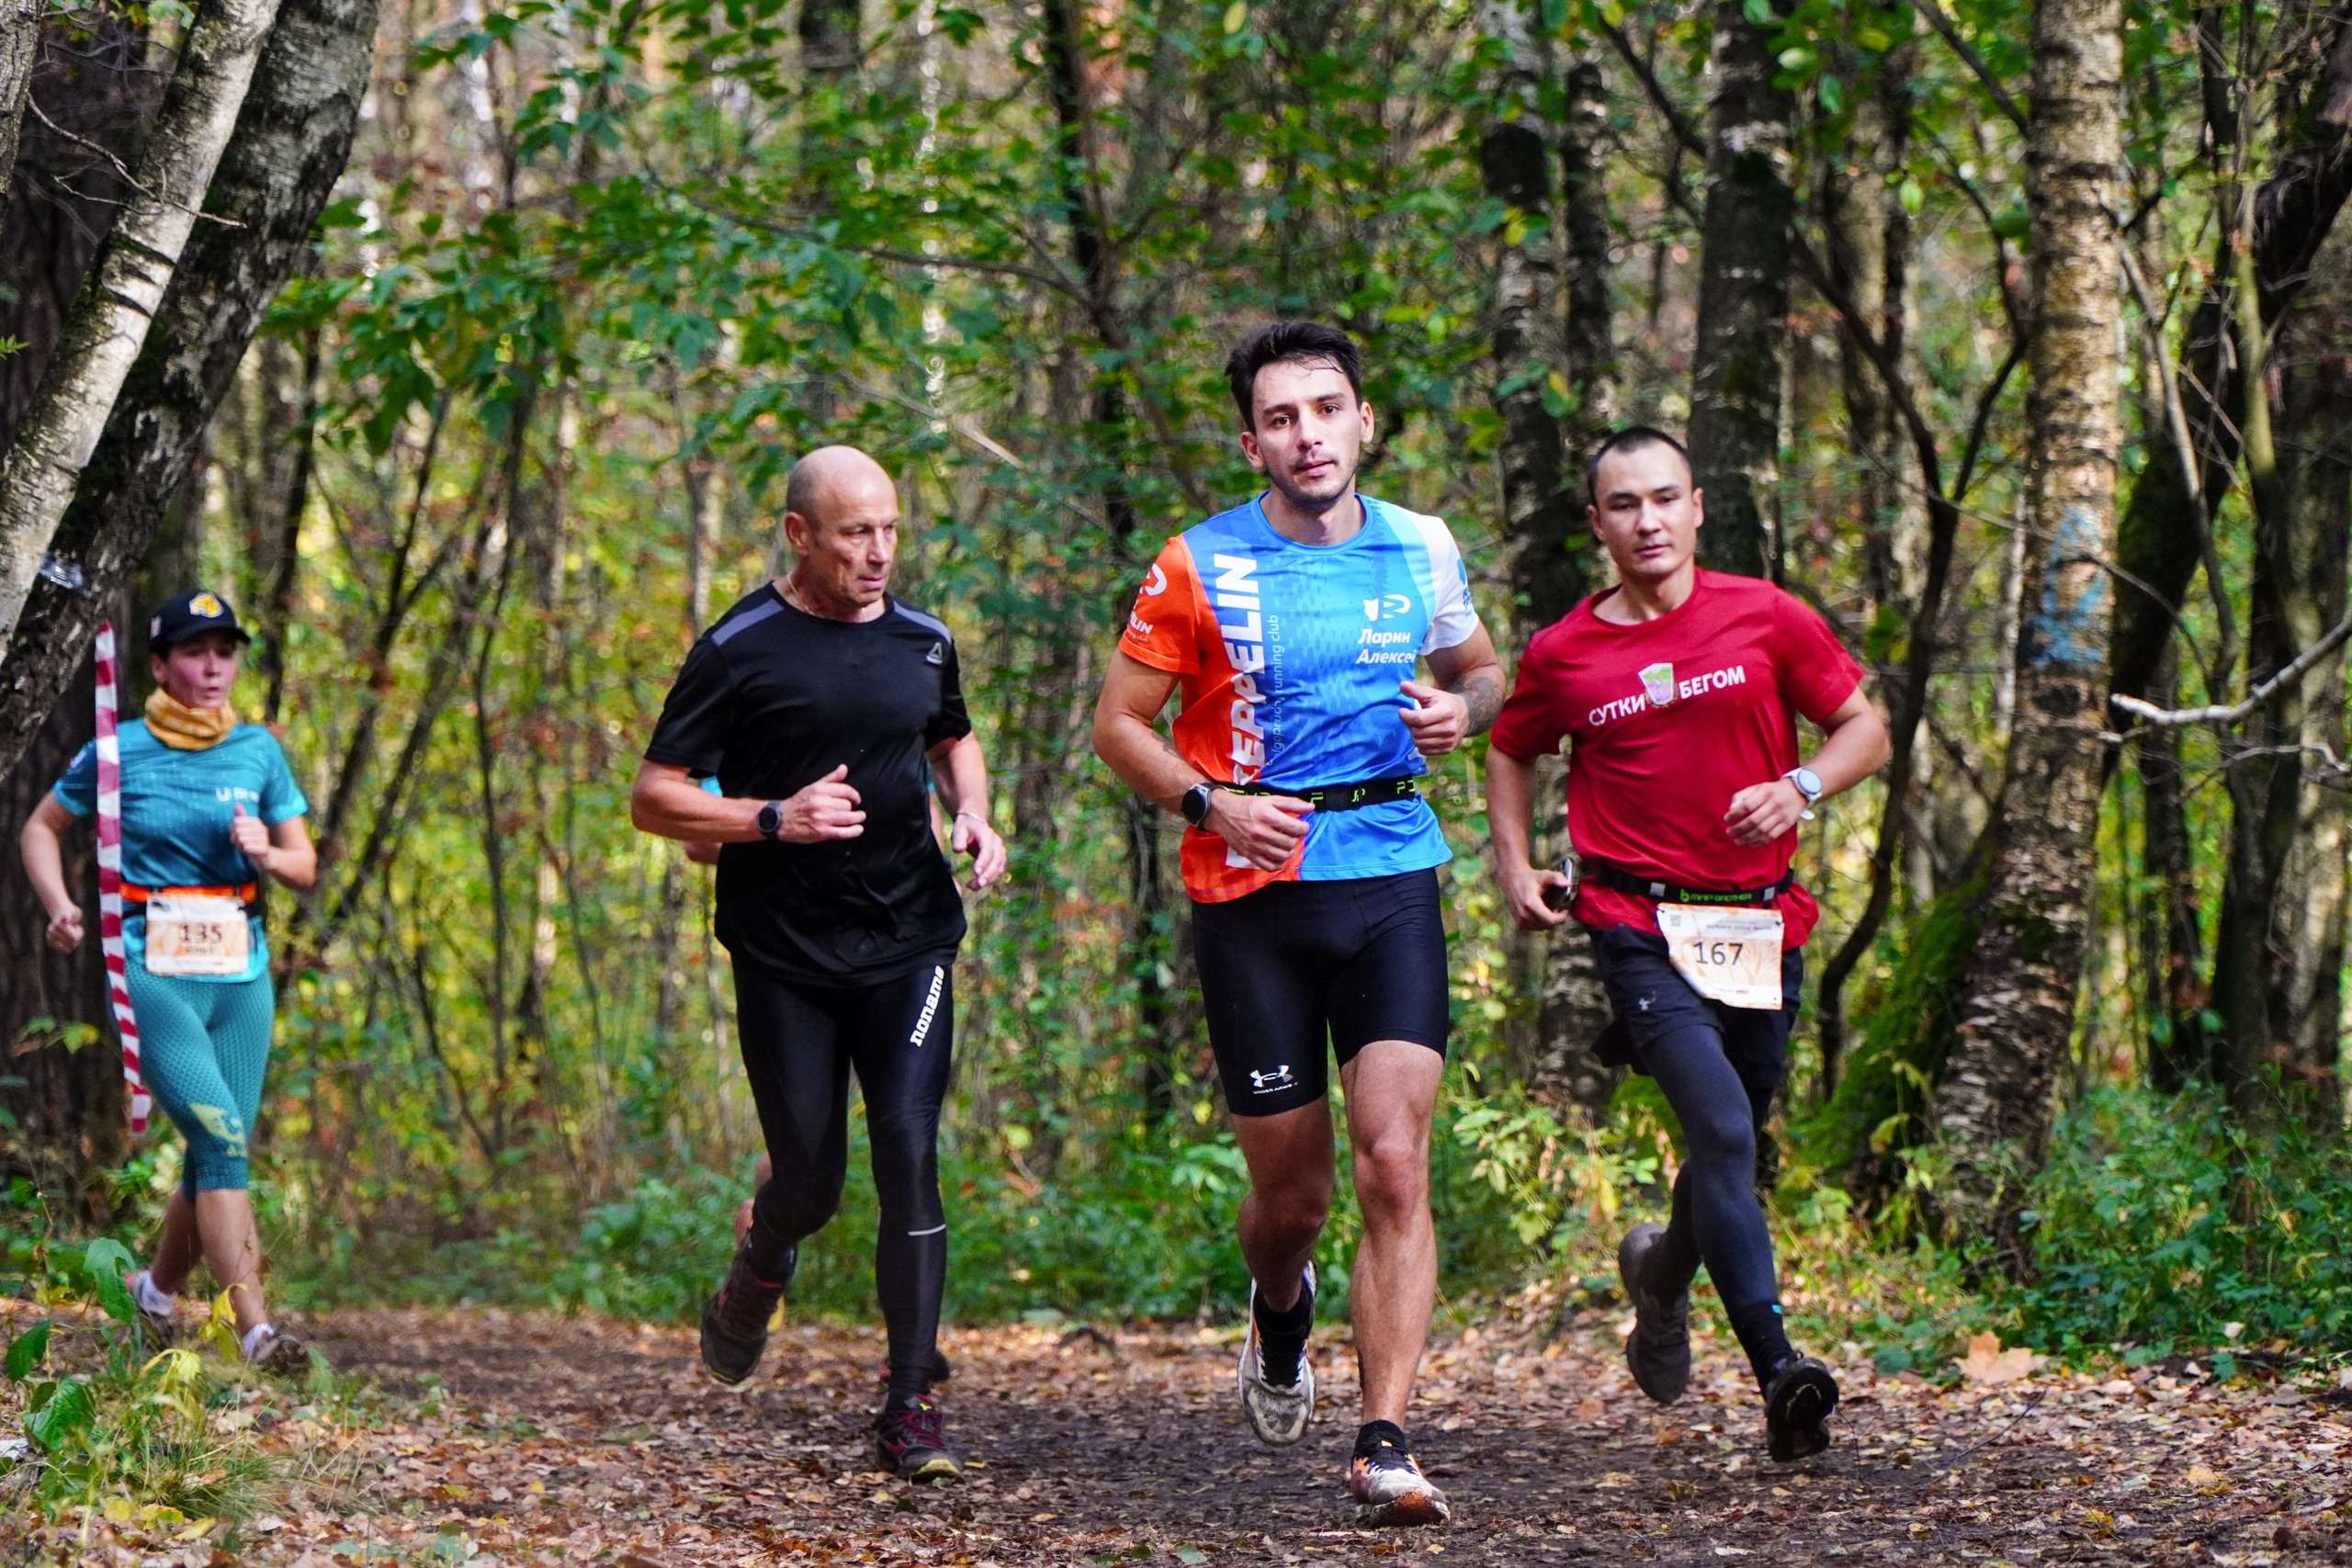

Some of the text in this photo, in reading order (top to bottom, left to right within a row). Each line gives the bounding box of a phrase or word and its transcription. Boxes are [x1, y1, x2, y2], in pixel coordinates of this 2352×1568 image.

[1267, 615, 1281, 642] club
[1358, 628, 1411, 648] Ларин
[1271, 645, 1285, 694] running
[1589, 665, 1746, 727] СУТКИ БЕГОМ
[182, 922, 222, 943] 135
[1693, 942, 1744, 965] 167
